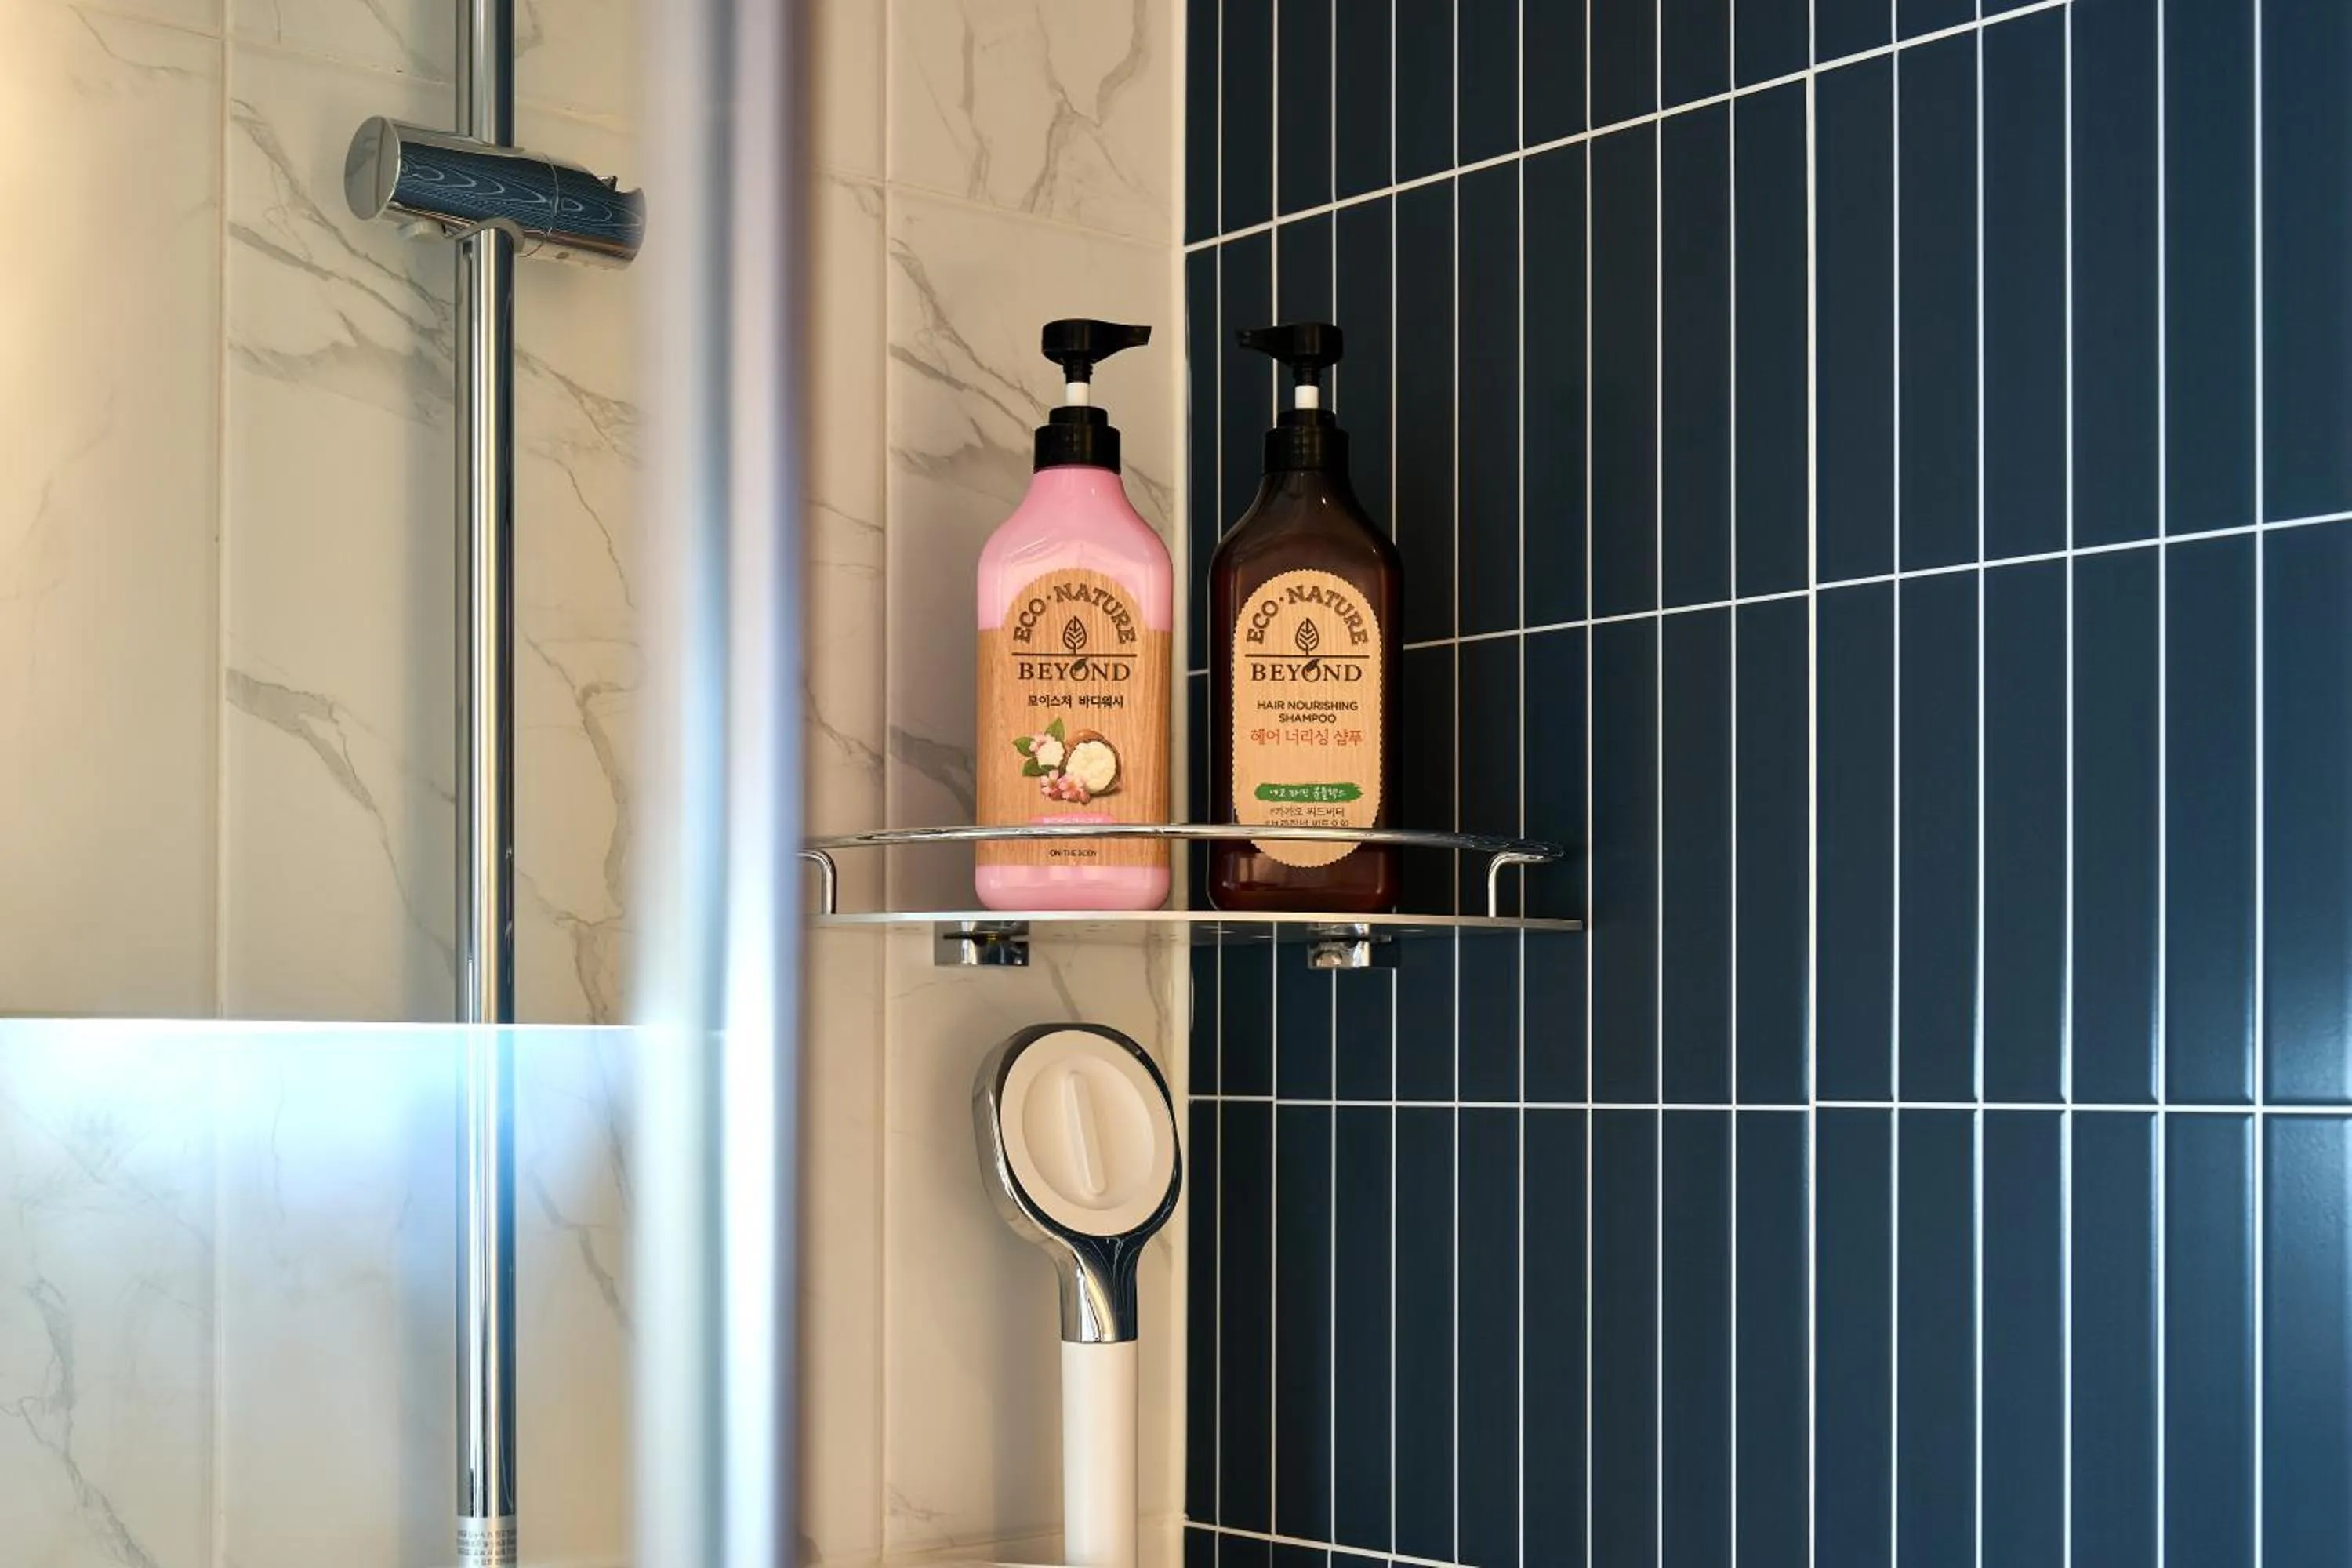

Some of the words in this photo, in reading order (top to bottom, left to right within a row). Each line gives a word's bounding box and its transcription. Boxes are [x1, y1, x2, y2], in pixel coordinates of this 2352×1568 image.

[1018, 659, 1131, 681] BEYOND
[1251, 659, 1363, 682] BEYOND
[1028, 694, 1073, 708] 모이스처
[1078, 694, 1123, 708] 바디워시
[1257, 700, 1285, 710] HAIR
[1287, 700, 1359, 711] NOURISHING
[1279, 713, 1337, 724] SHAMPOO
[1250, 728, 1281, 746] 헤어
[1285, 728, 1330, 746] 너리싱
[1333, 728, 1363, 746] 샴푸
